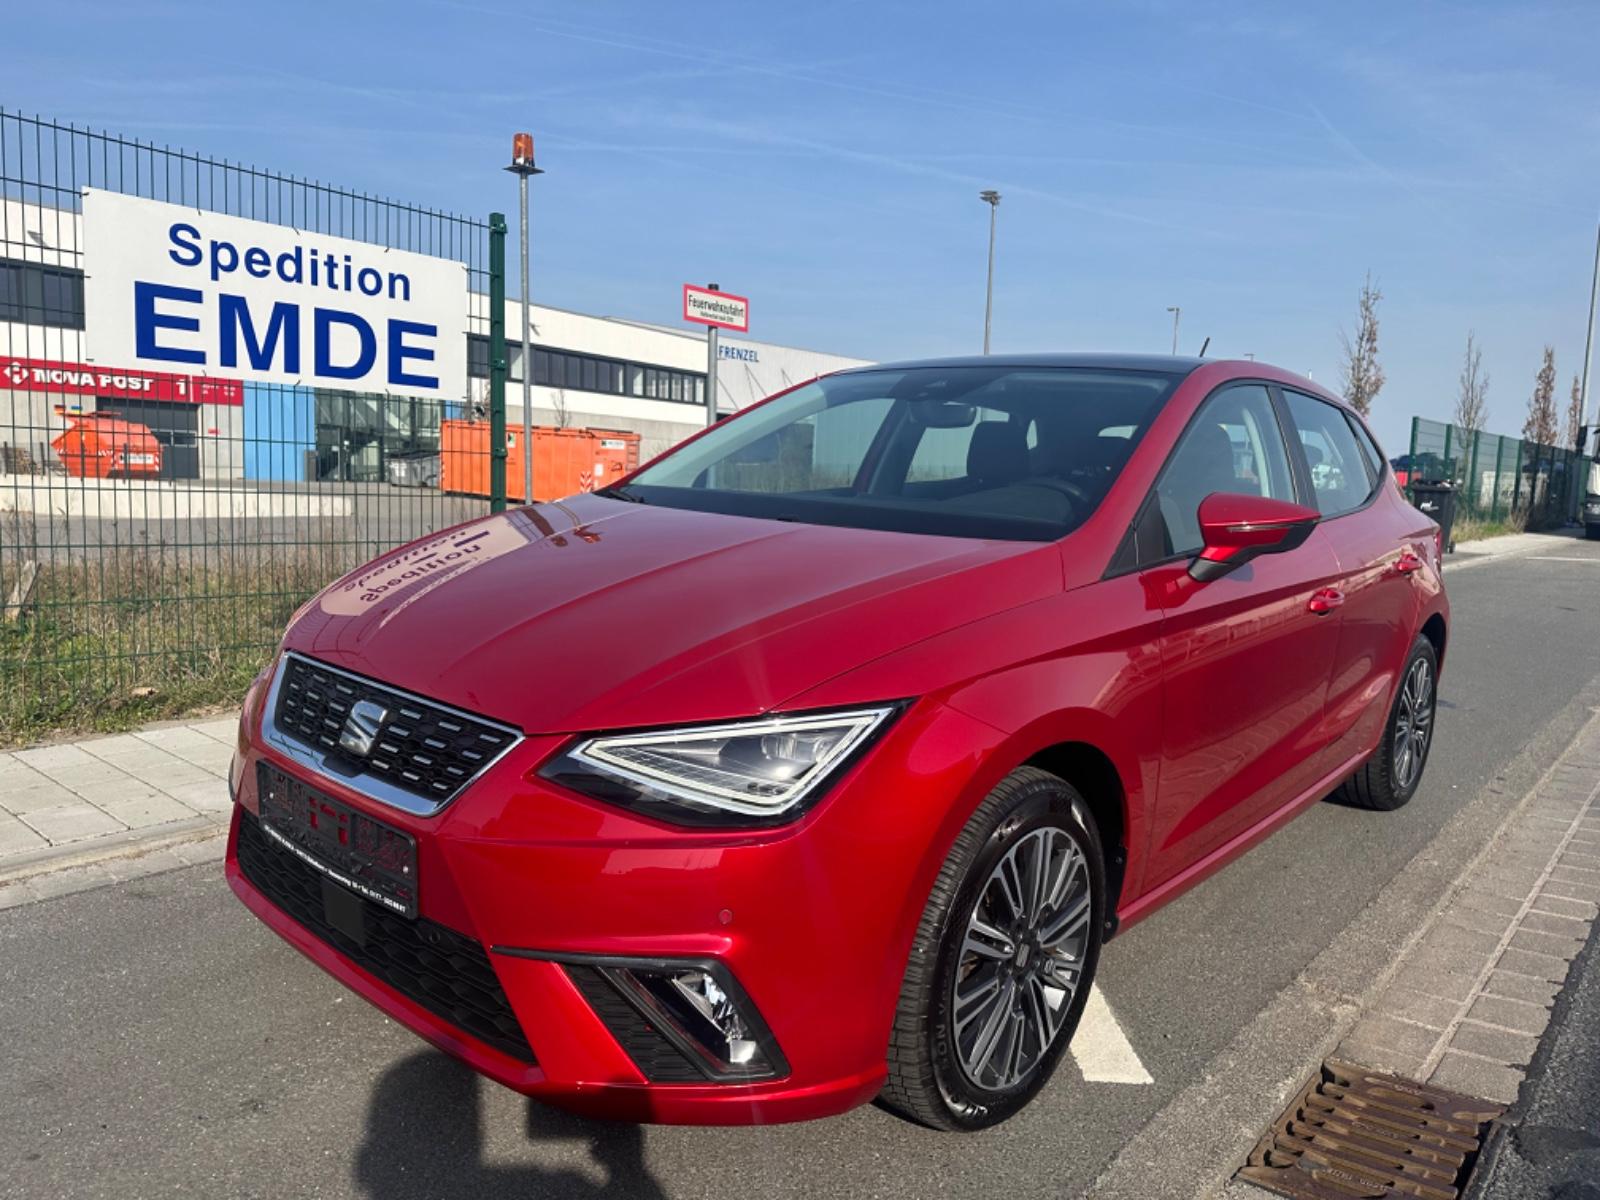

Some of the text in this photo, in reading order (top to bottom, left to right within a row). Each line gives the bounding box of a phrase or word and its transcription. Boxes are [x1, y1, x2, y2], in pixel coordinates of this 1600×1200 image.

[168, 223, 411, 301] Spedition
[134, 281, 440, 389] EMDE
[718, 345, 760, 362] FRENZEL
[32, 368, 96, 387] NOVA
[97, 373, 154, 391] POST
